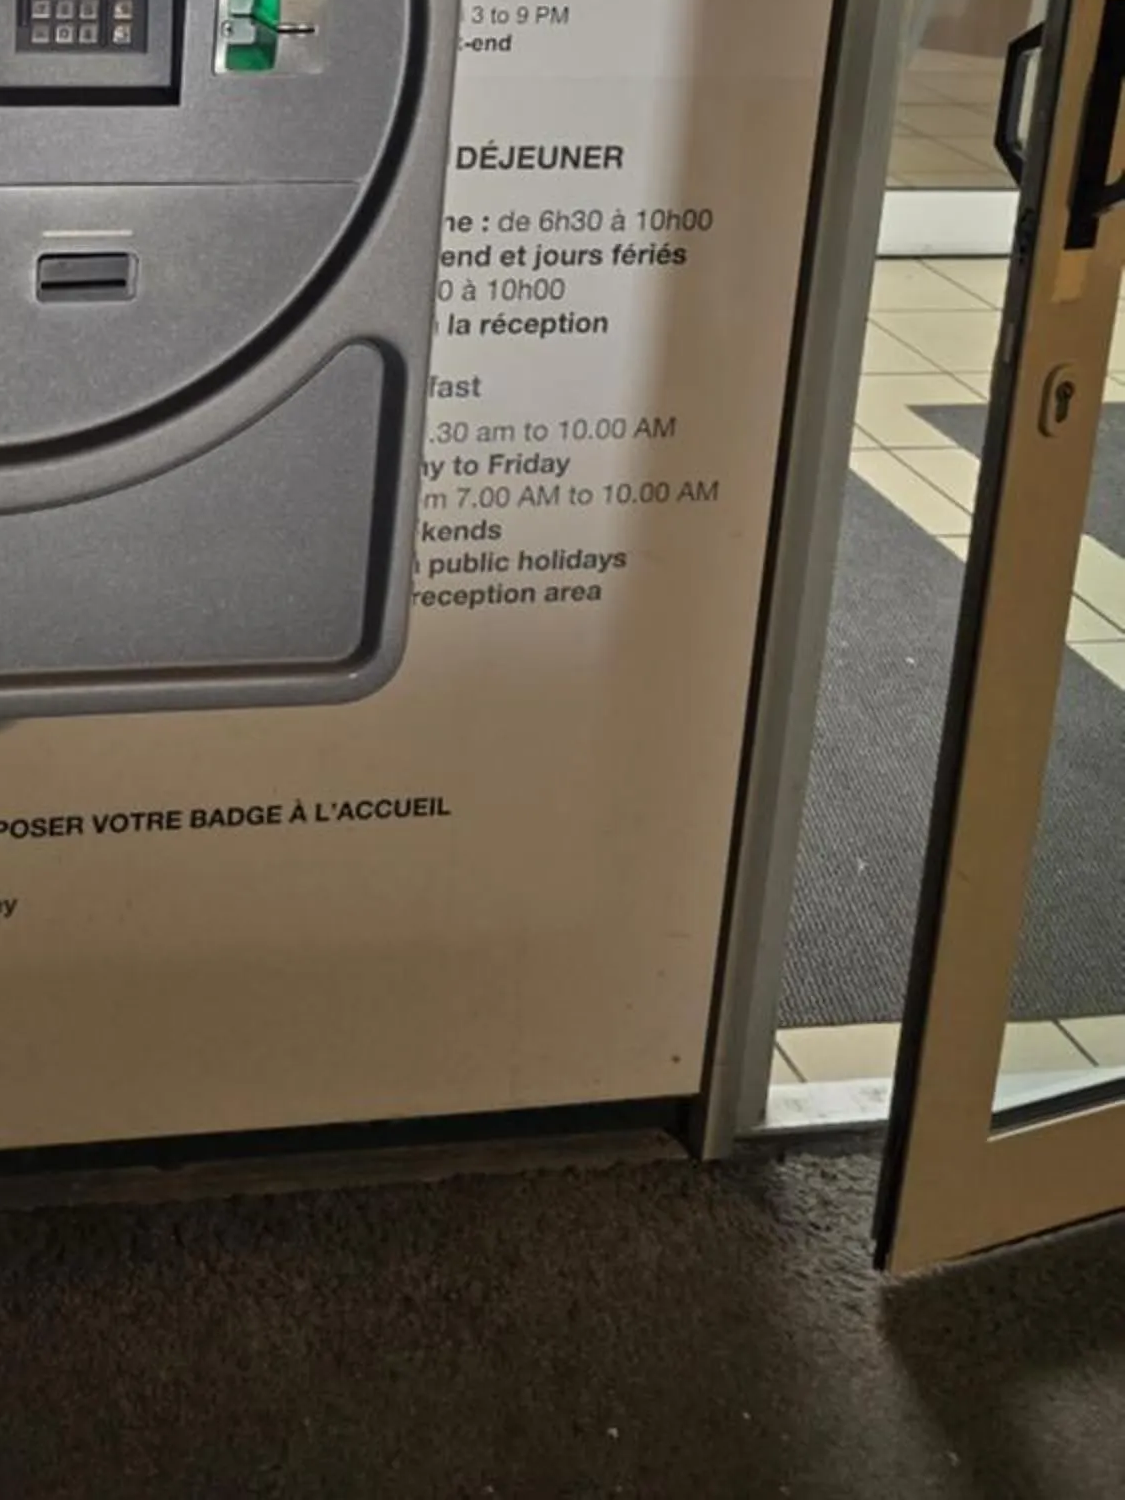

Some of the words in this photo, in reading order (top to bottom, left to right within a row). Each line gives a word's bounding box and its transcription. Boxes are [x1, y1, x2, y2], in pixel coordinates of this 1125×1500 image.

[471, 5, 484, 24] 3
[491, 7, 510, 24] to
[516, 6, 529, 24] 9
[535, 6, 569, 24] PM
[456, 140, 624, 170] DÉJEUNER
[498, 211, 530, 233] de
[539, 210, 602, 232] 6h30
[610, 208, 625, 231] à
[638, 208, 713, 232] 10h00
[500, 246, 526, 266] et
[533, 243, 602, 270] jours
[613, 242, 688, 266] fériés
[461, 279, 476, 301] à
[488, 278, 565, 301] 10h00
[448, 314, 471, 335] la
[480, 312, 609, 339] réception
[476, 425, 515, 443] am
[524, 423, 548, 442] to
[560, 418, 626, 440] 10.00
[633, 416, 678, 438] AM
[453, 456, 478, 476] to
[488, 453, 570, 479] Friday
[457, 487, 510, 509] 7.00
[517, 485, 560, 507] AM
[569, 485, 593, 505] to
[603, 482, 670, 505] 10.00
[677, 480, 720, 502] AM
[429, 552, 509, 578] public
[518, 549, 627, 575] holidays
[412, 584, 536, 609] reception
[544, 584, 602, 602] area
[91, 810, 182, 835] VOTRE
[190, 804, 282, 829] BADGE
[289, 799, 307, 823] À
[315, 797, 451, 821] L'ACCUEIL
